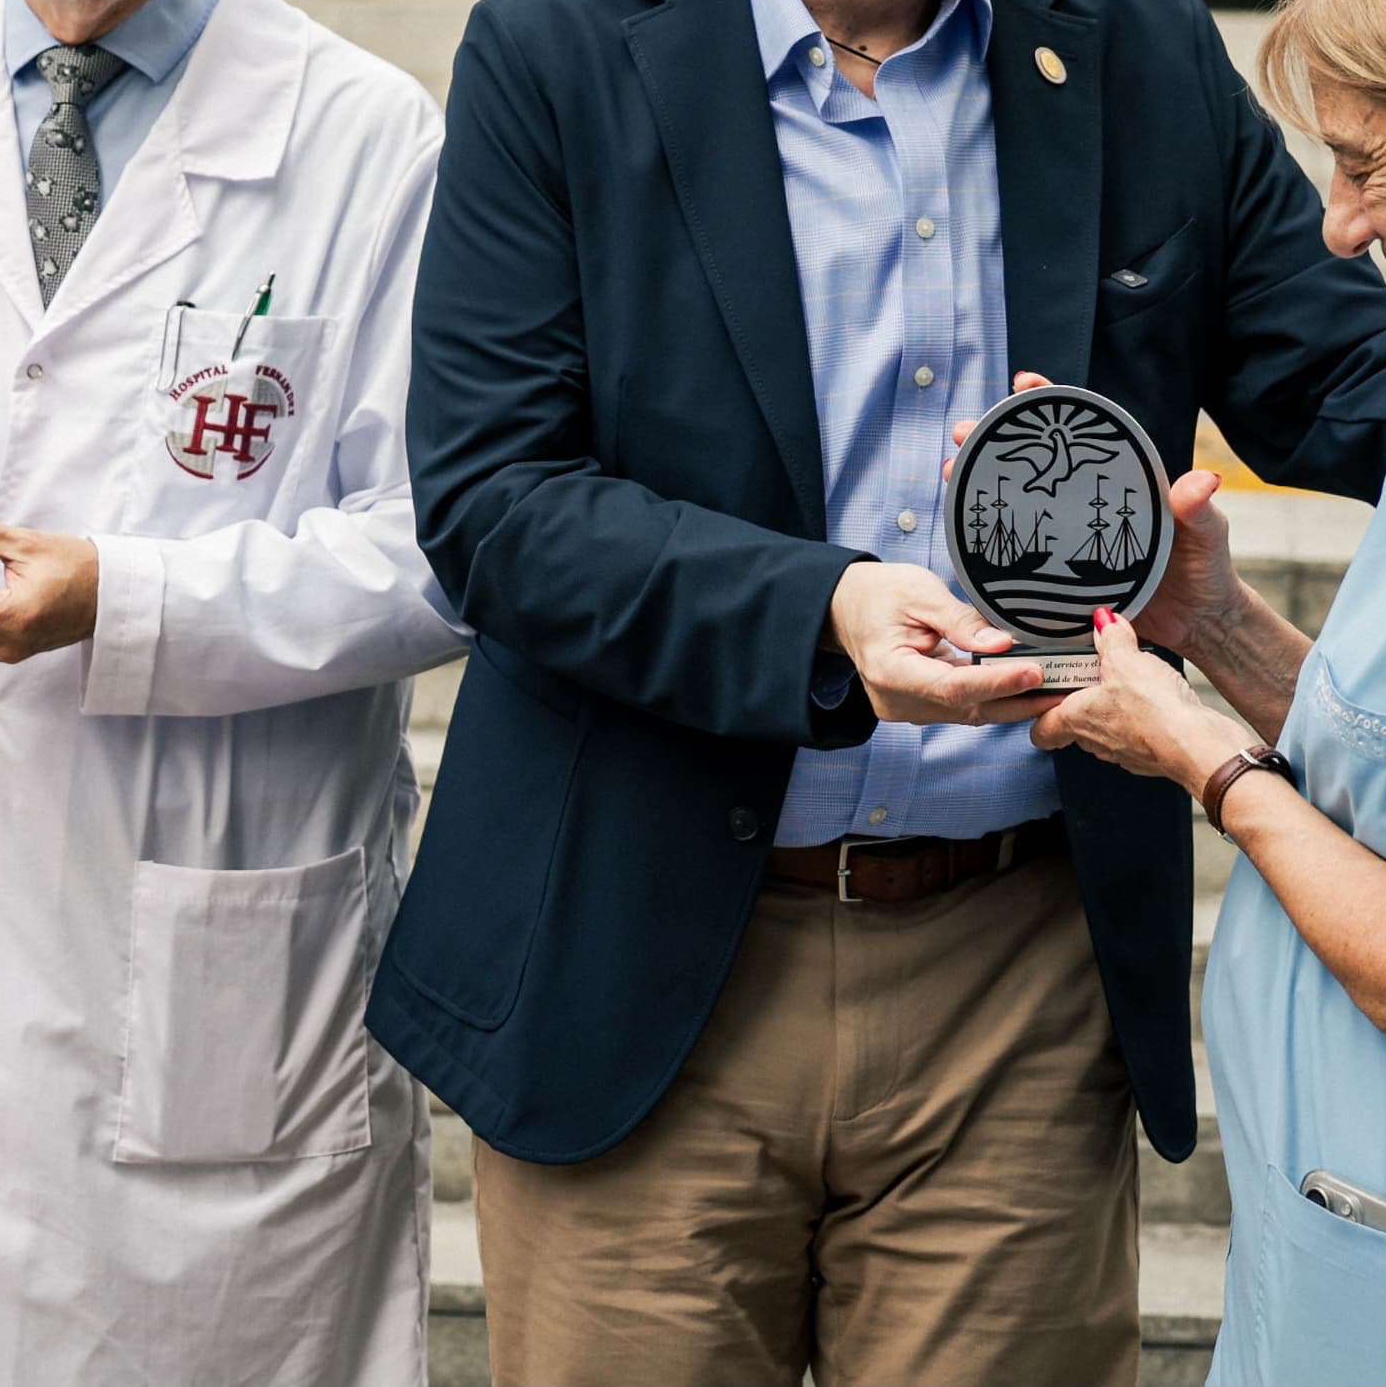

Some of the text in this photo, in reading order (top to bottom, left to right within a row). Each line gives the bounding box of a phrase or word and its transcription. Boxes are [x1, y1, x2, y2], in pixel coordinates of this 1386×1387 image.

[169, 364, 295, 417] HOSPITAL FERNANDEZ
[183, 394, 277, 462] HF
[1045, 661, 1053, 669] el
[1054, 661, 1082, 669] servicio
[1090, 659, 1098, 667] el
